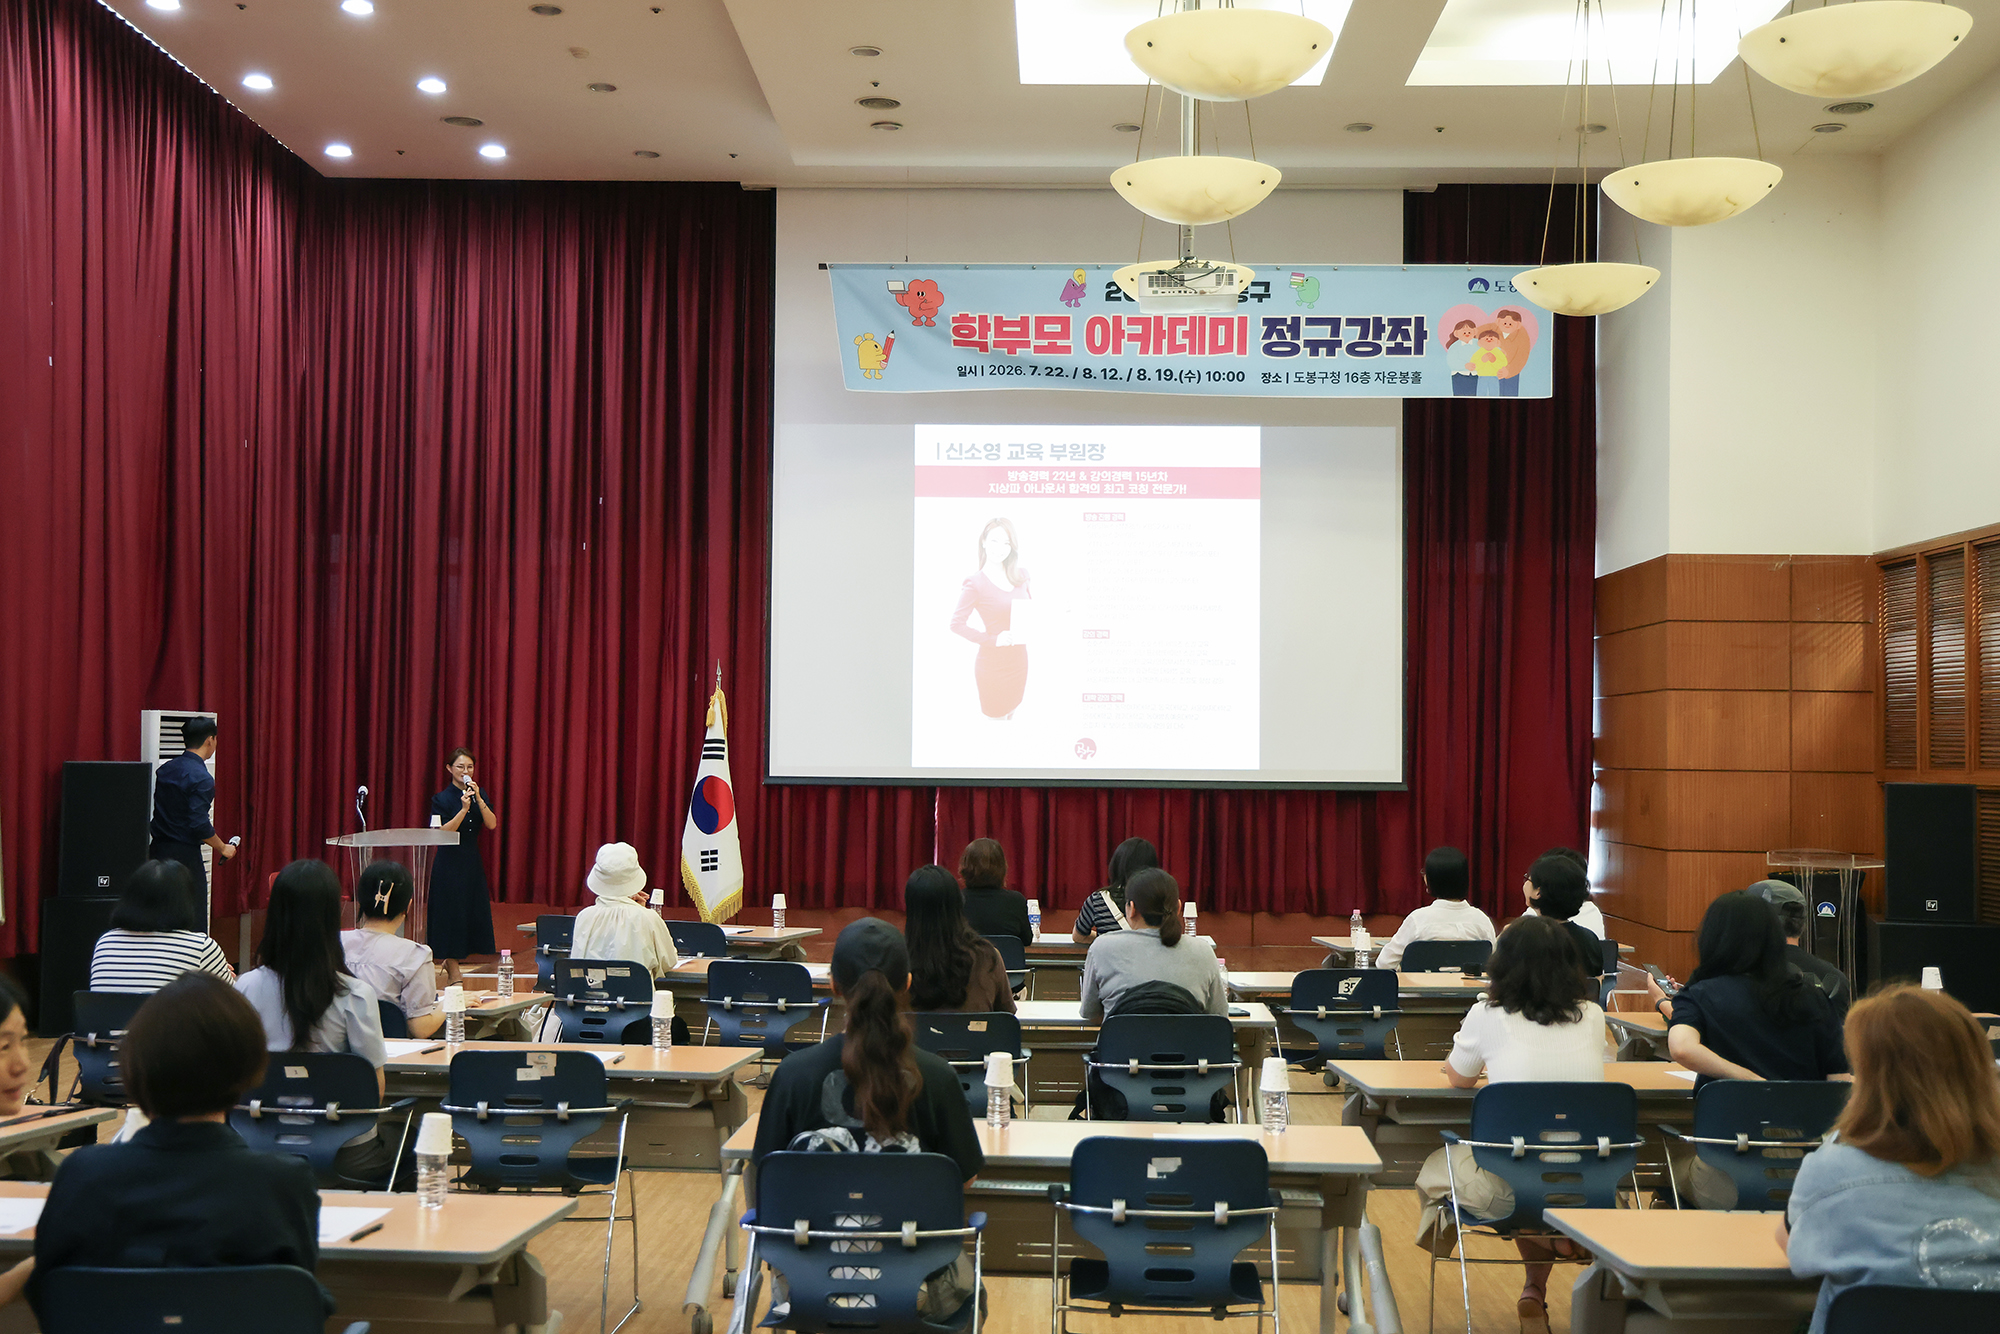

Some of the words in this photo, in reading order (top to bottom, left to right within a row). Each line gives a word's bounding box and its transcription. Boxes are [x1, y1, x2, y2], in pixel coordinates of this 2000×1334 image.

[951, 313, 1073, 355] 학부모
[1085, 314, 1248, 356] 아카데미
[1260, 315, 1428, 358] 정규강좌
[957, 365, 977, 377] 일시
[989, 364, 1026, 376] 2026.
[1045, 366, 1069, 378] 22.
[1100, 368, 1123, 380] 12.
[1205, 370, 1246, 382] 10:00
[1261, 372, 1282, 384] 장소
[1293, 371, 1341, 384] 도봉구청
[1344, 371, 1371, 384] 16층
[1374, 371, 1422, 384] 자운봉홀
[945, 442, 1001, 461] 신소영
[1007, 443, 1044, 461] 교육
[1049, 443, 1106, 461] 부원장
[1007, 471, 1049, 482] 방송경력
[1052, 471, 1076, 482] 22년
[1079, 471, 1087, 482] &
[1090, 471, 1132, 482] 강의경력
[1135, 471, 1168, 482] 15년차
[988, 483, 1020, 494] 지상파
[1023, 483, 1065, 494] 아나운서
[1103, 483, 1125, 494] 최고
[1128, 483, 1149, 495] 코칭
[1152, 483, 1187, 495] 전문가!
